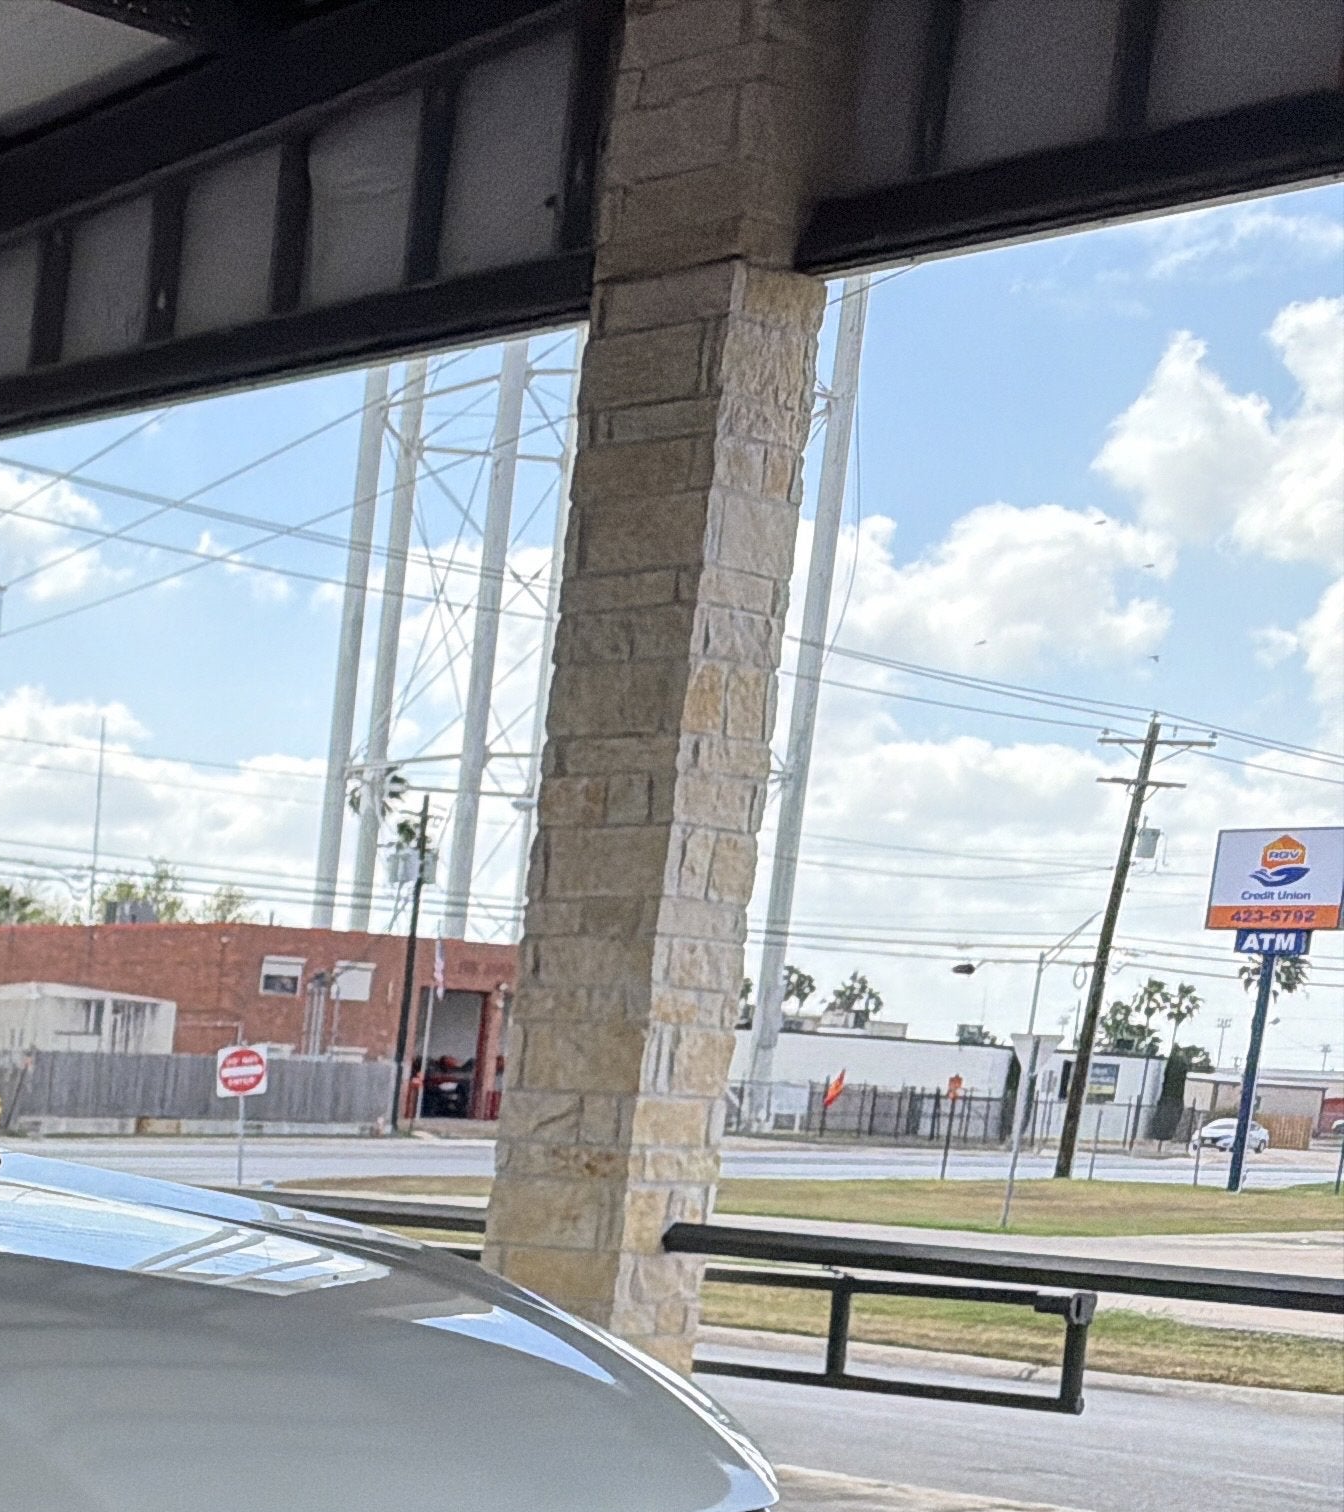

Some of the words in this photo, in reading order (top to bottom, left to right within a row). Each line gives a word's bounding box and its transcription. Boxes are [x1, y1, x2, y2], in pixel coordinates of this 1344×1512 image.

[1241, 890, 1275, 900] Credit
[1277, 890, 1311, 900] Union
[1241, 933, 1296, 950] ATM
